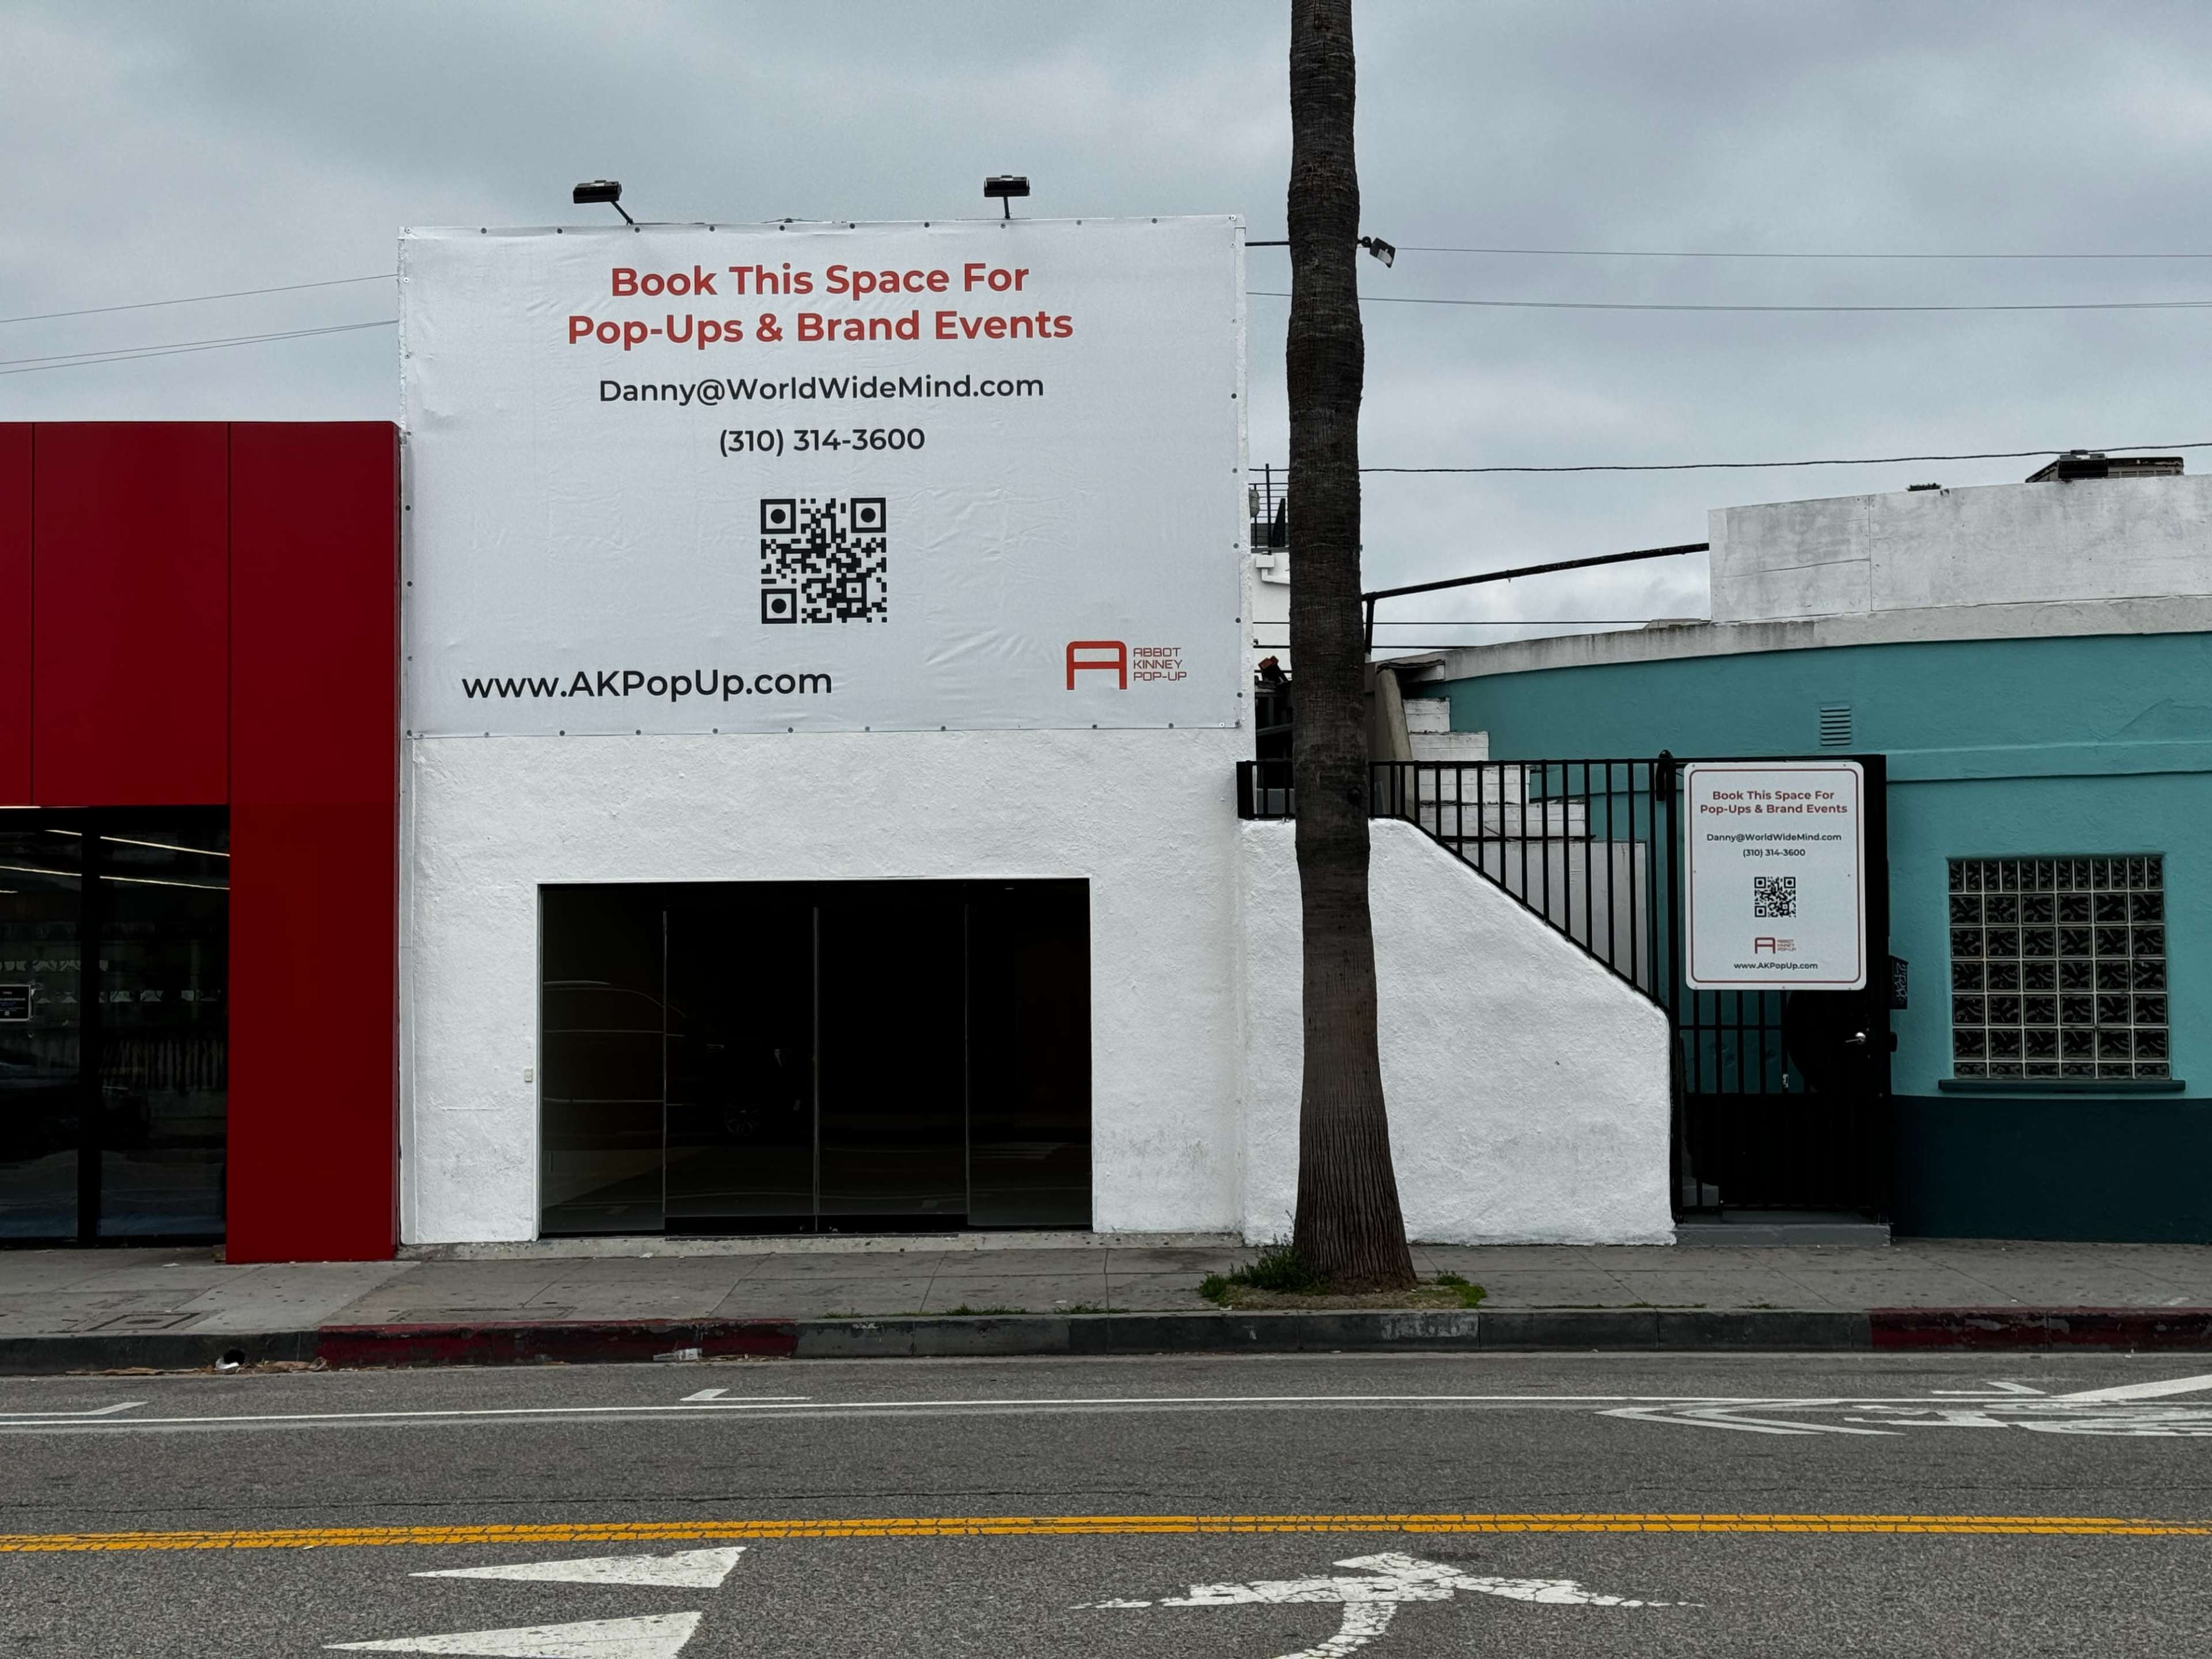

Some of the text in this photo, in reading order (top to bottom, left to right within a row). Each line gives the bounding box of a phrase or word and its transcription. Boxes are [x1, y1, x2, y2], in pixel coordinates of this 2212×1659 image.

[612, 263, 1029, 301] Book This Space For
[569, 310, 1073, 351] Pop-Ups & Brand Events
[601, 374, 1043, 406] Danny@WorldWideMind.com
[721, 429, 925, 457] (310) 314-3600
[1134, 647, 1181, 657] ABBOT
[1134, 660, 1182, 669] KINNEY
[1134, 672, 1187, 681] POP-UP
[462, 669, 831, 702] www.AKPopUp.com
[1713, 790, 1834, 802] Book This Space For
[1700, 804, 1847, 816] Pop-Ups & Brand Events
[1707, 833, 1842, 842] Danny@WorldWideMind.com
[1743, 849, 1763, 858] (310)
